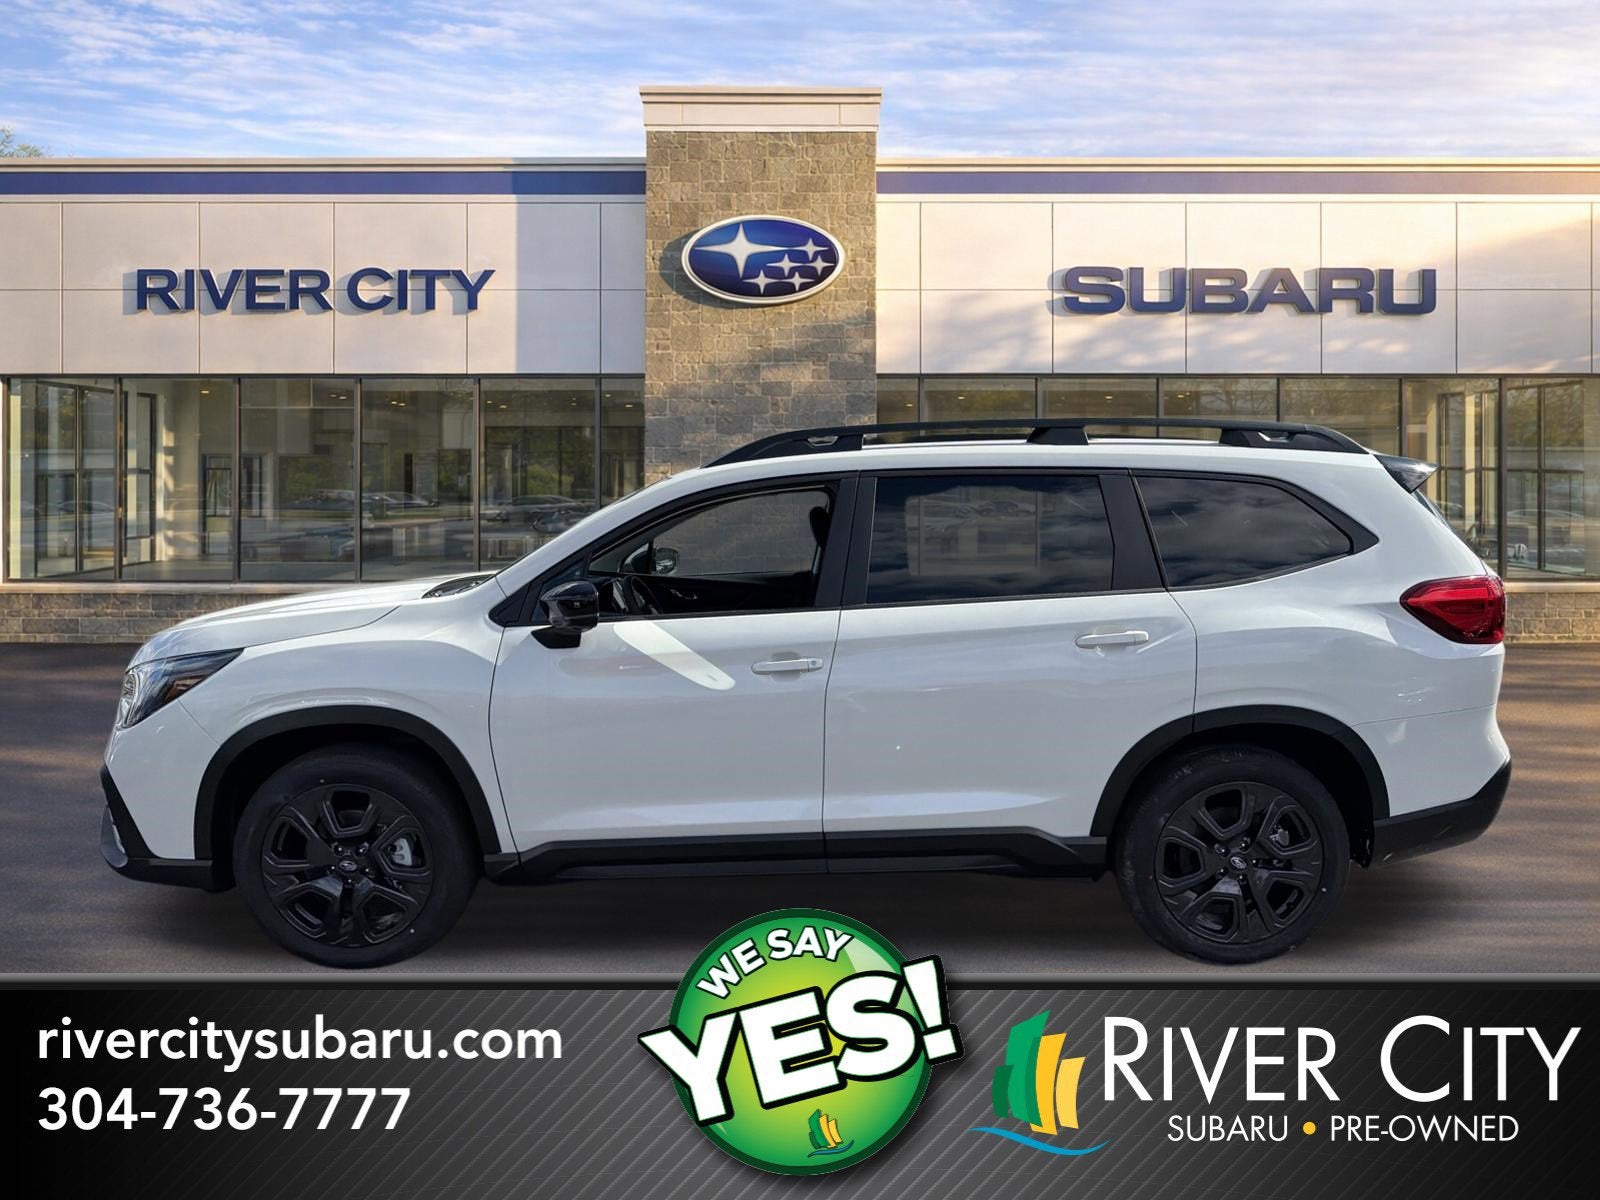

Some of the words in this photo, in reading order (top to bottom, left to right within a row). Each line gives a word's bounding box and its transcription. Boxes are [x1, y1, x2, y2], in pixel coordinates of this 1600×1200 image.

[136, 268, 334, 312] RIVER
[347, 267, 496, 312] CITY
[1062, 266, 1437, 315] SUBARU
